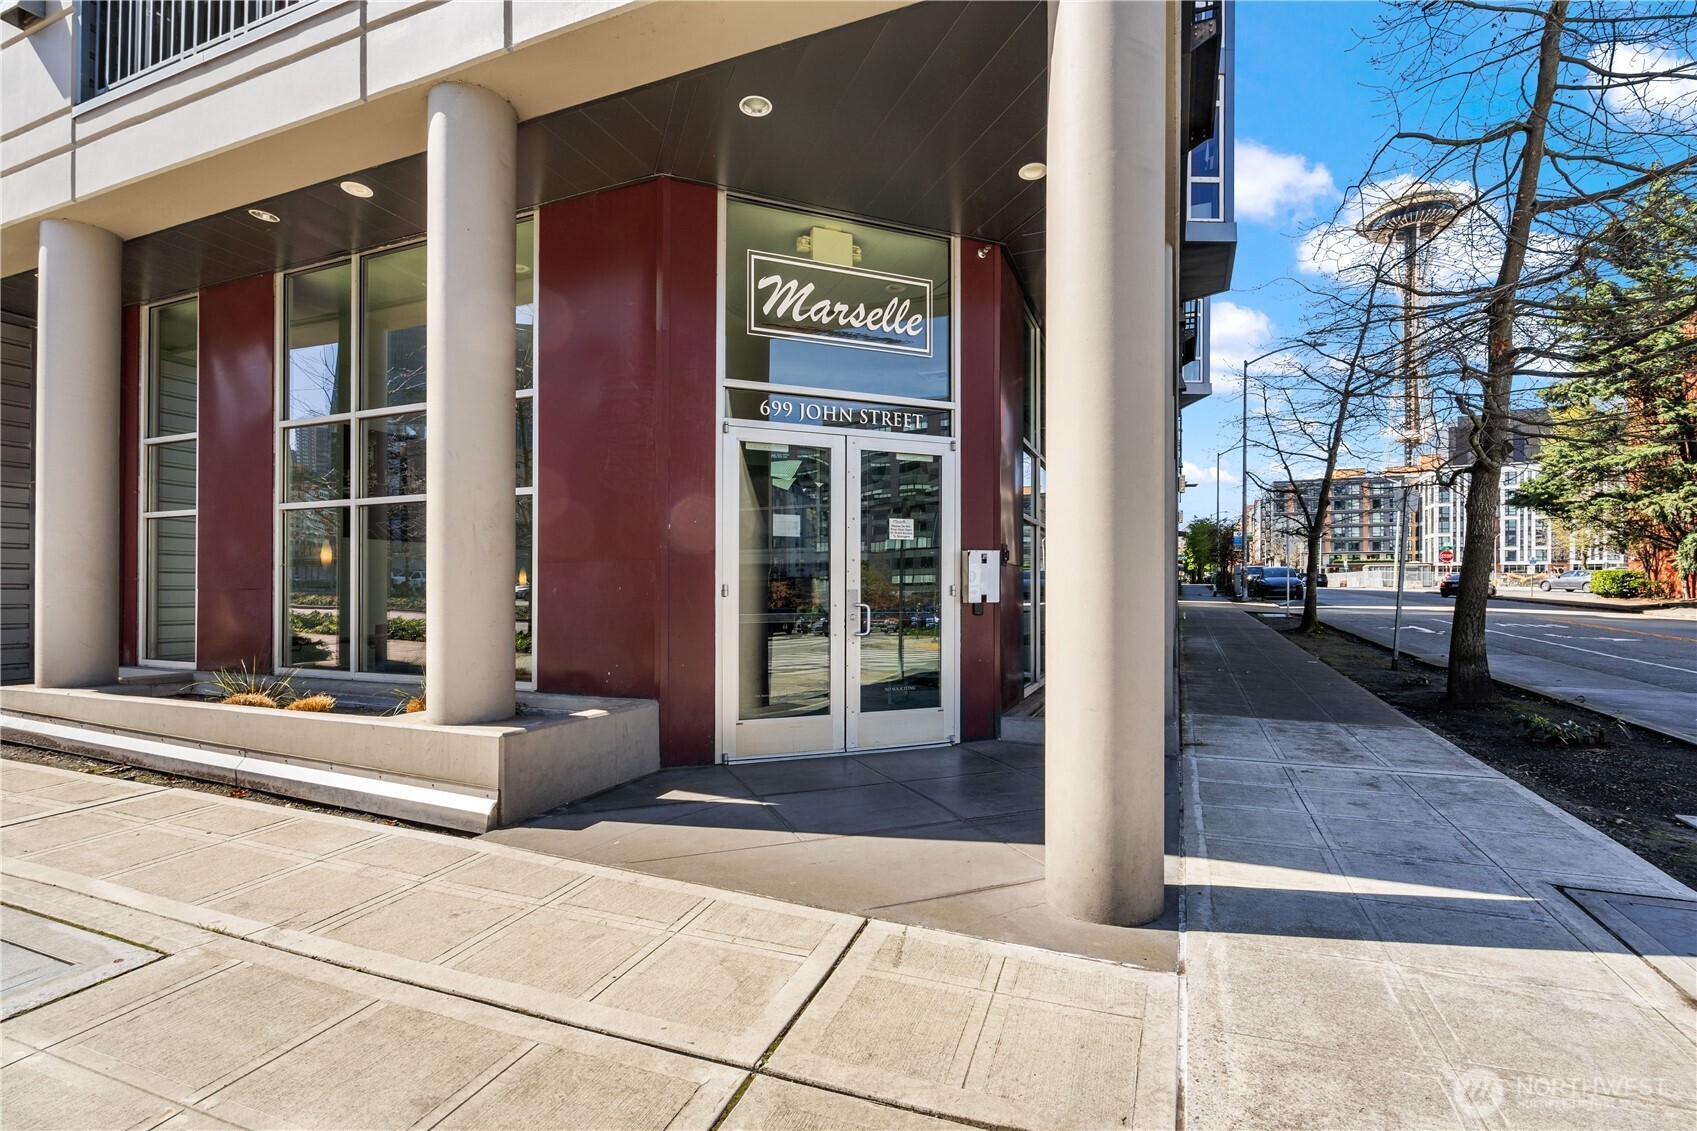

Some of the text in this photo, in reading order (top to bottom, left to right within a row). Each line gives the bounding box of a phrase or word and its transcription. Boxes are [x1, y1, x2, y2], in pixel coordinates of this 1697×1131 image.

[757, 274, 923, 336] Marselle
[759, 400, 924, 429] 699 JOHN STREET
